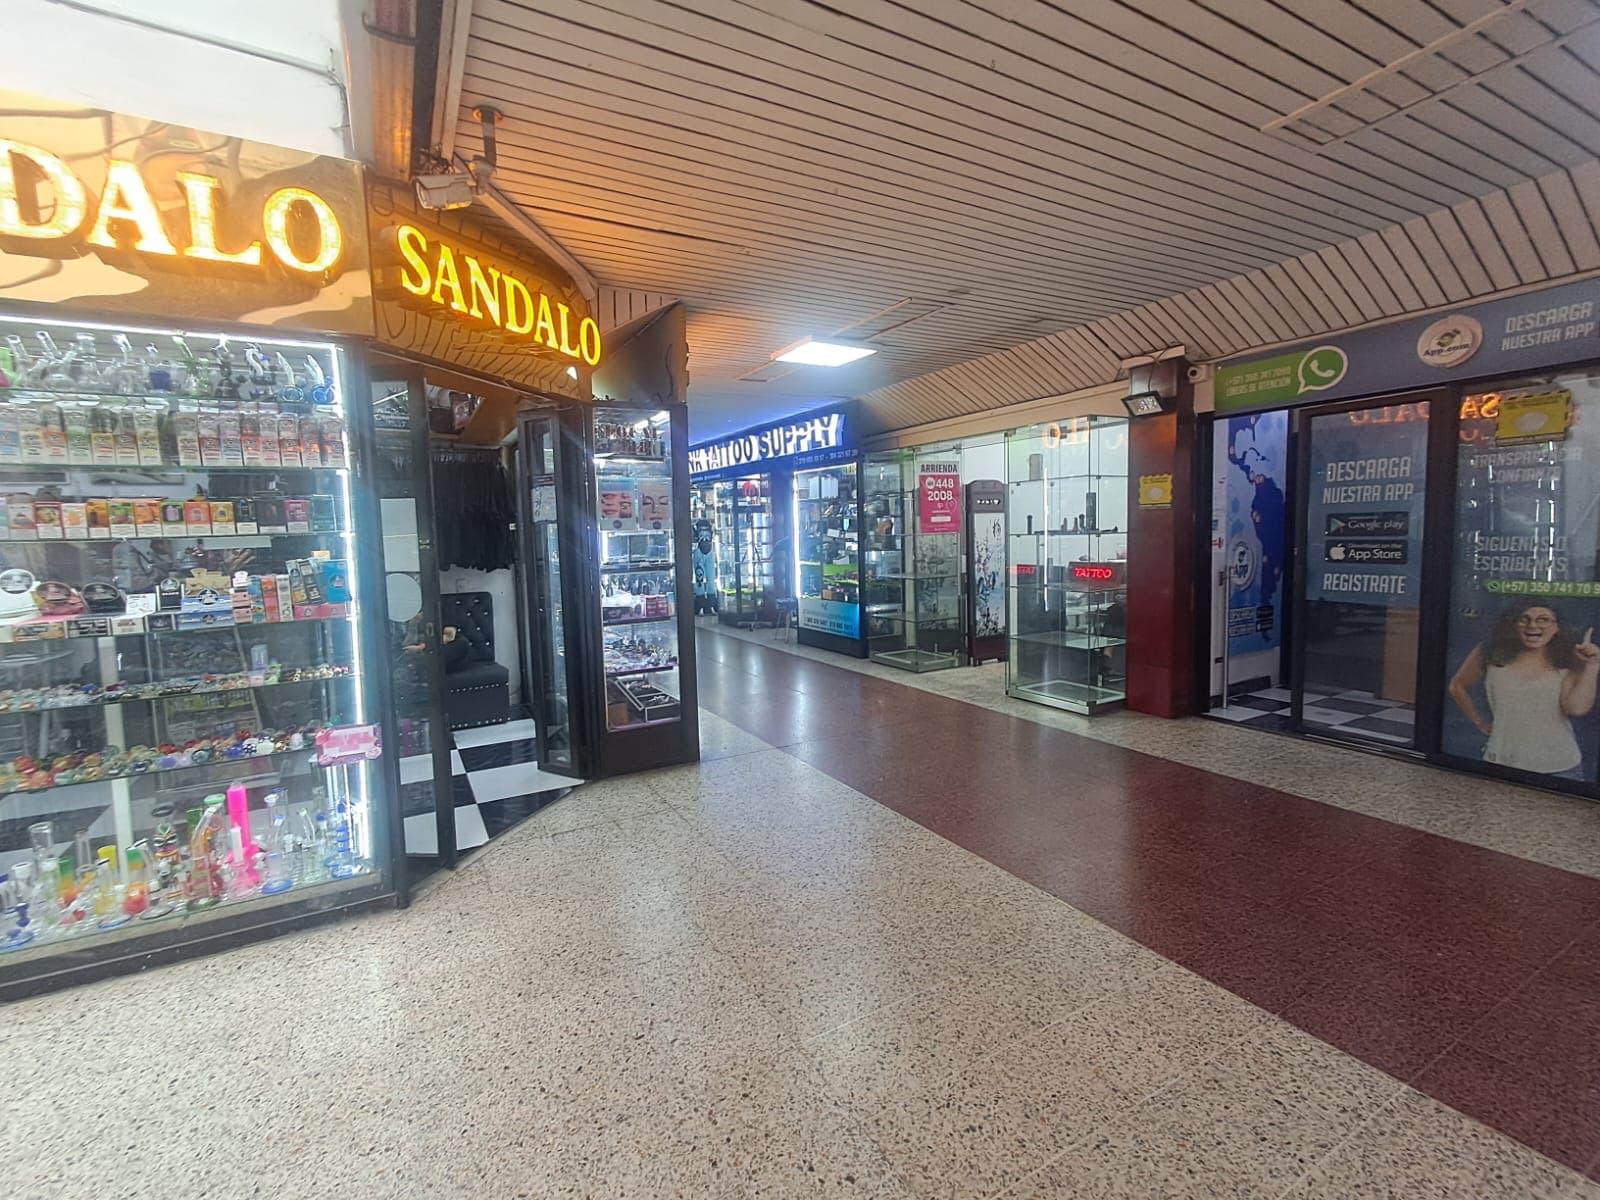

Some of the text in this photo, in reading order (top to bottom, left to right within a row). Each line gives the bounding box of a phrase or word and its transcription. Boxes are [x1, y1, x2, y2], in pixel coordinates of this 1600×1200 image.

[396, 224, 602, 367] SANDALO
[1505, 301, 1594, 333] DESCARGA
[1501, 321, 1597, 351] NUESTRA APP
[703, 436, 755, 471] TATTOO
[757, 413, 842, 458] SUPPLY
[920, 463, 958, 473] ARRIENDA
[1326, 456, 1412, 482] DESCARGA
[935, 477, 954, 489] 448
[928, 490, 953, 501] 2008
[1322, 483, 1415, 504] NUESTRA APP
[1348, 519, 1404, 532] Google play
[1348, 548, 1402, 561] App Store
[1074, 567, 1112, 578] TATTOO
[1323, 573, 1406, 595] REGISTRATE
[1501, 582, 1527, 593] (+57)
[1530, 582, 1551, 593] 350
[1552, 582, 1575, 593] 741
